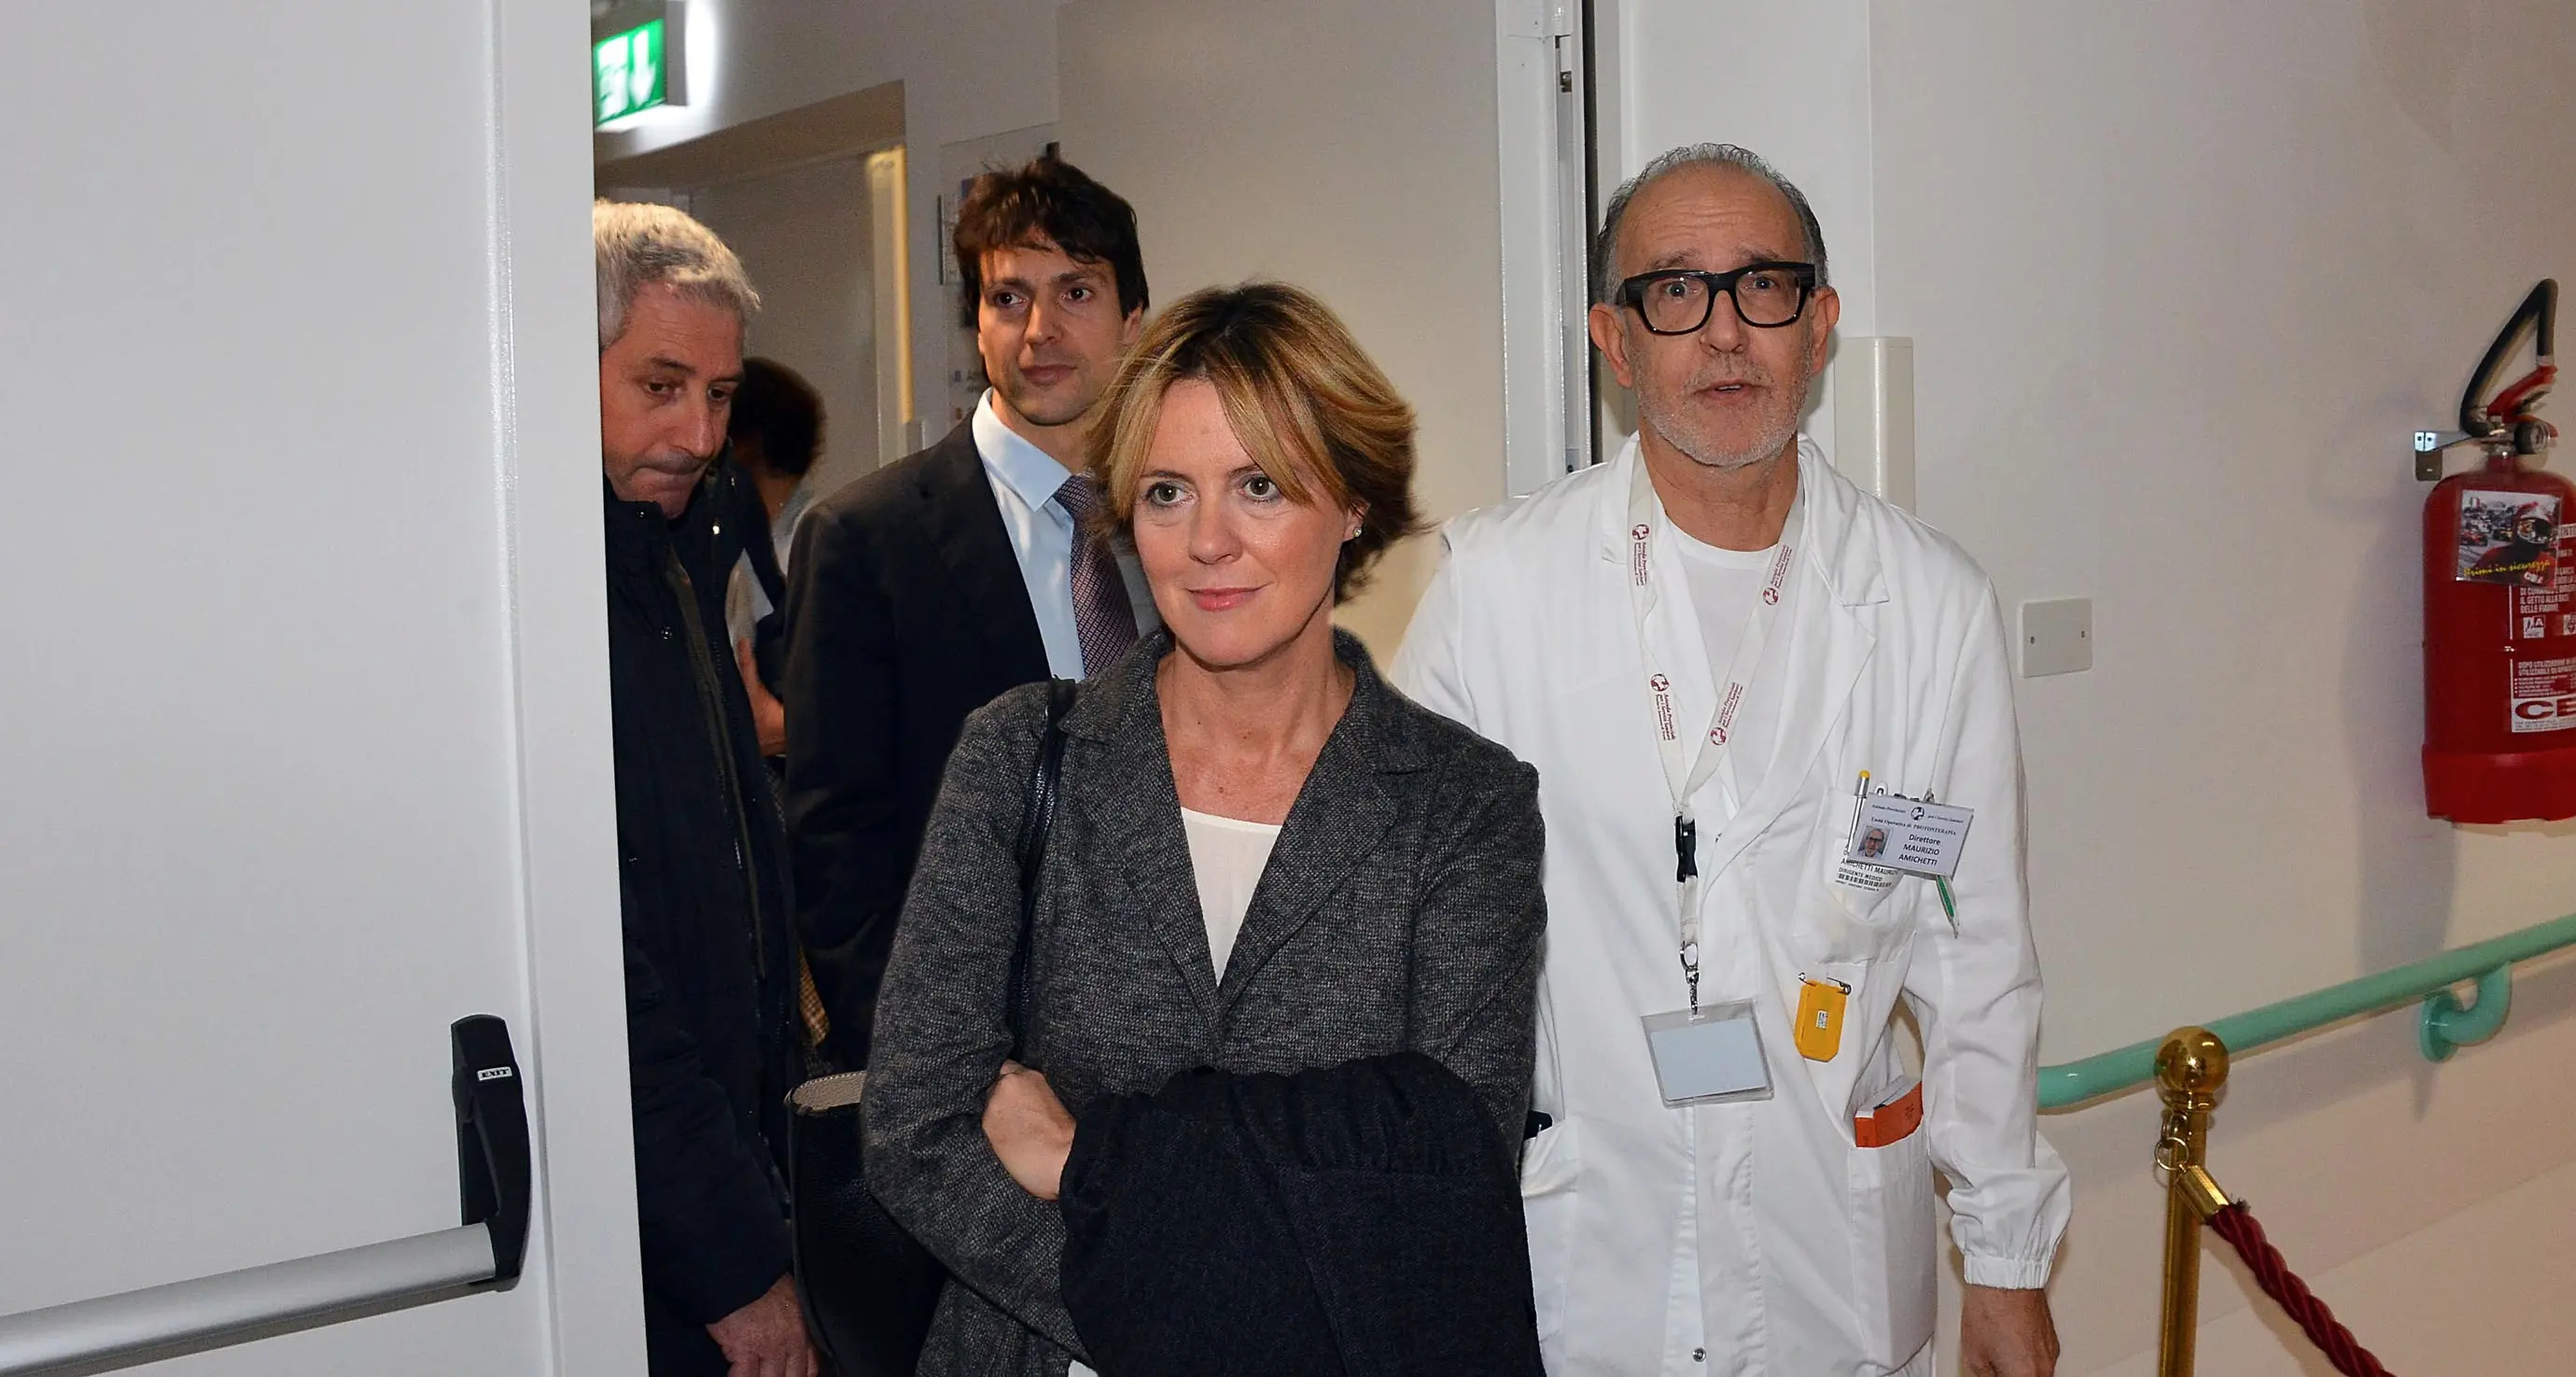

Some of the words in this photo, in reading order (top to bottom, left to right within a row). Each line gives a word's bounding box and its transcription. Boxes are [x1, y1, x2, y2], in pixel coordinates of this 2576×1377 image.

[1909, 834, 1940, 846] Direttore
[1903, 844, 1940, 856] MAURIZIO
[1897, 854, 1938, 865] AMICHETTI
[482, 1069, 510, 1077] EXIT
